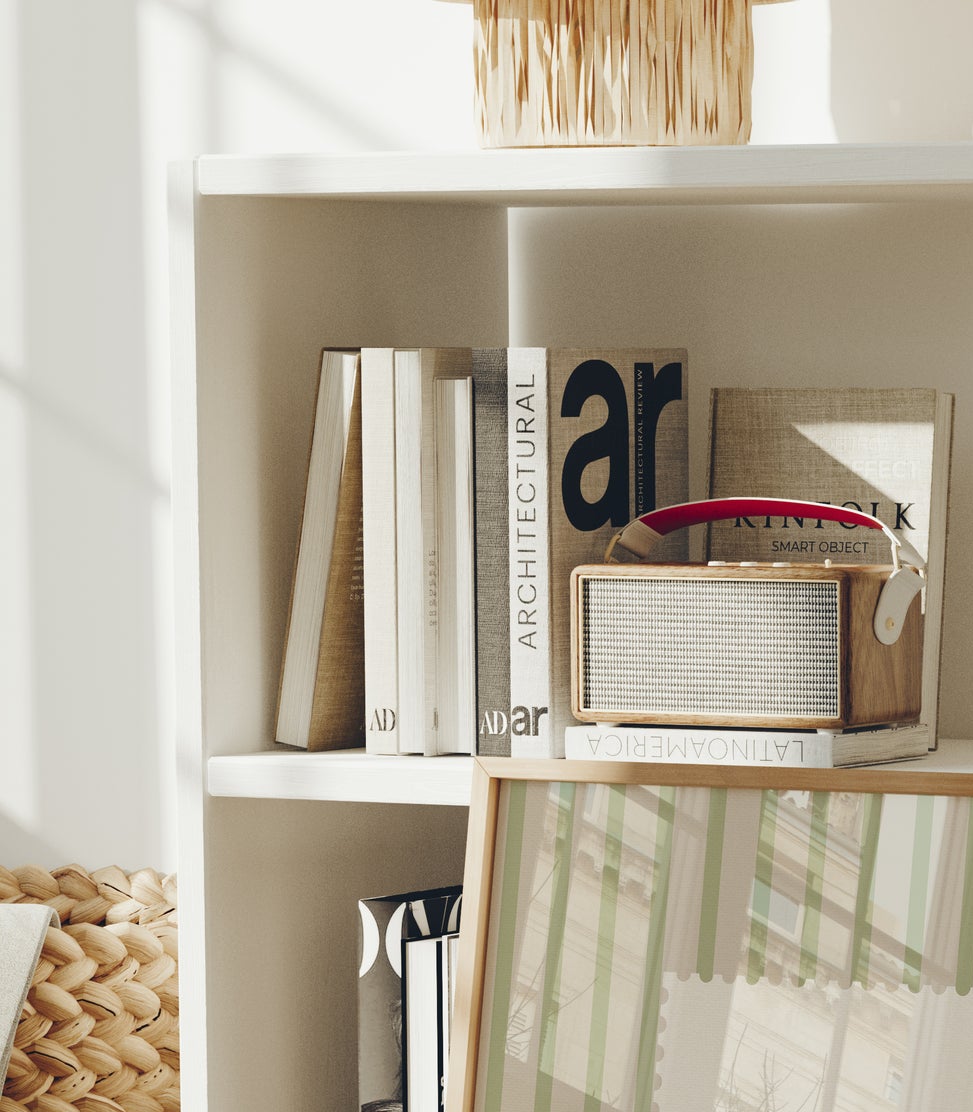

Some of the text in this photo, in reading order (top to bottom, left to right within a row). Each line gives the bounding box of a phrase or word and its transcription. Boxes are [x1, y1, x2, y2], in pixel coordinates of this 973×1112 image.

[561, 359, 683, 531] ar
[515, 373, 537, 649] ARCHITECTURAL
[772, 541, 869, 554] SMART OBJECT
[370, 708, 396, 732] AD
[479, 710, 508, 735] AD
[511, 705, 549, 737] ar
[586, 733, 805, 763] LATINOAMERICA
